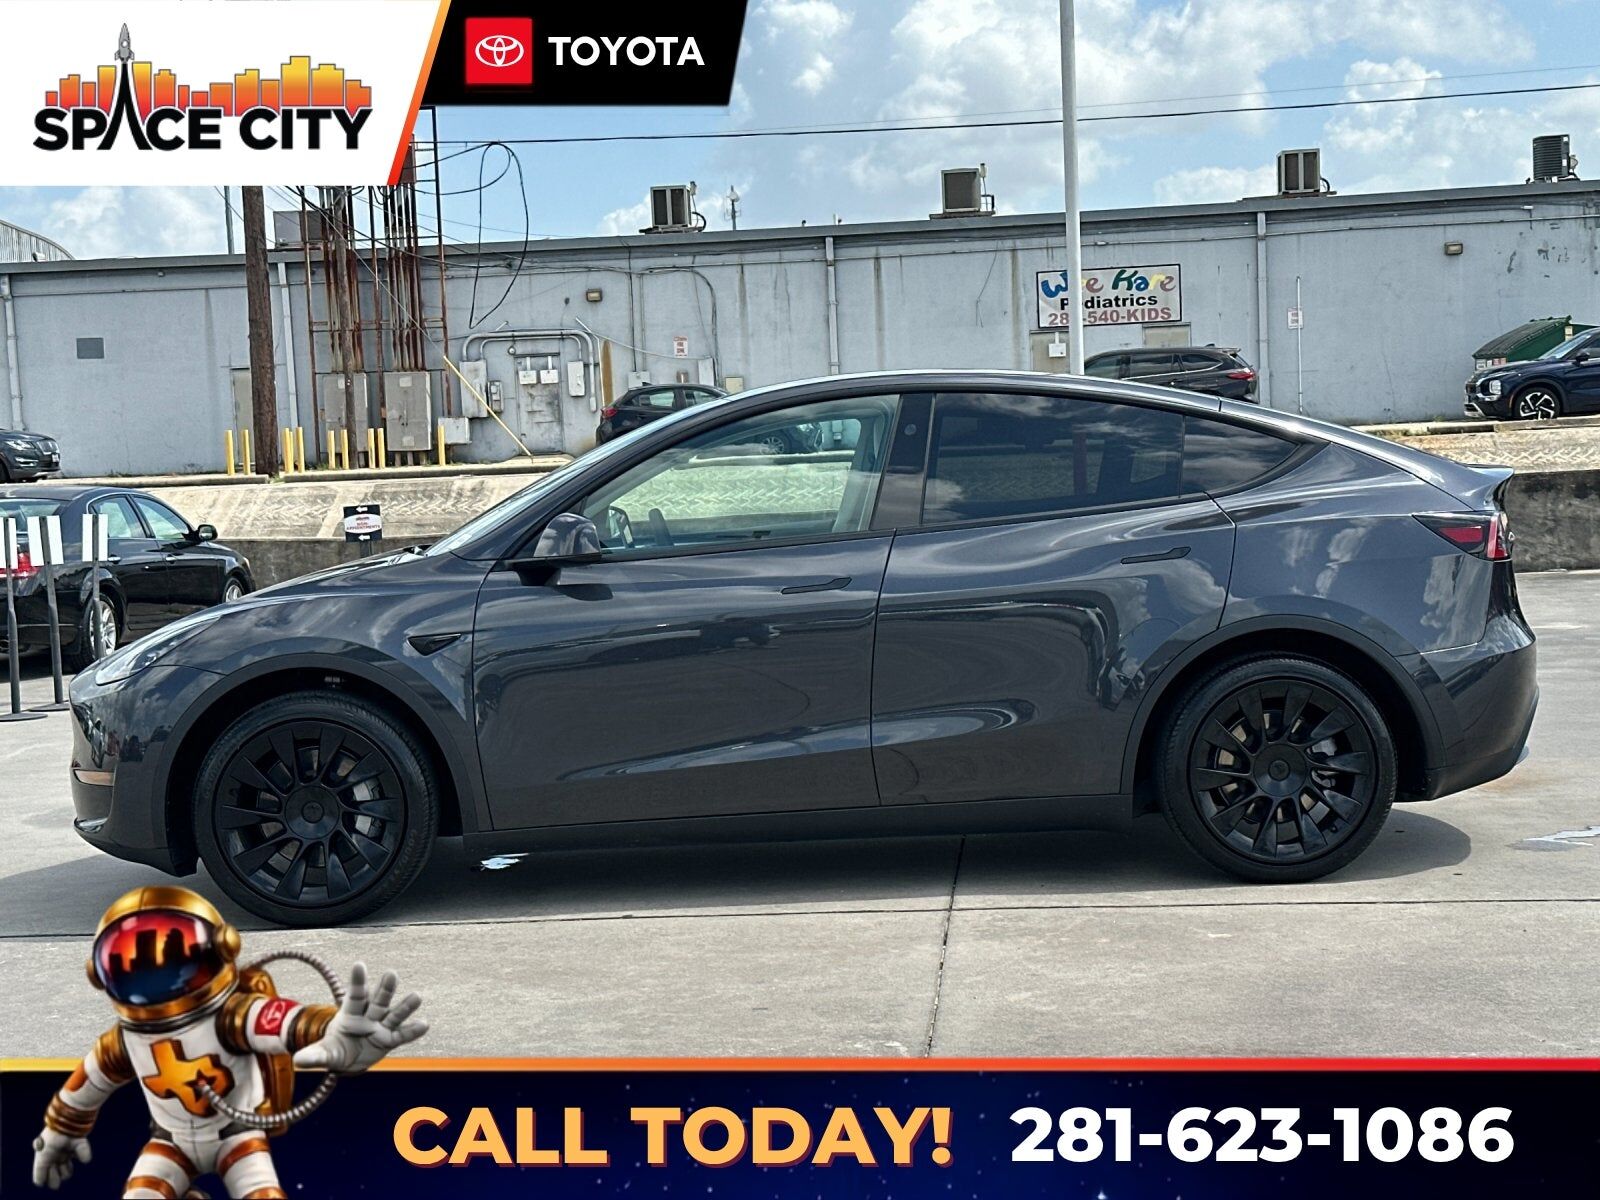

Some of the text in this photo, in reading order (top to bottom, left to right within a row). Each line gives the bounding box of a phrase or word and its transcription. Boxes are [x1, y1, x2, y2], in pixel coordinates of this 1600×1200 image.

[1041, 269, 1176, 299] We Kare
[1060, 294, 1158, 311] Pdiatrics
[1048, 307, 1172, 326] 28-540-KIDS
